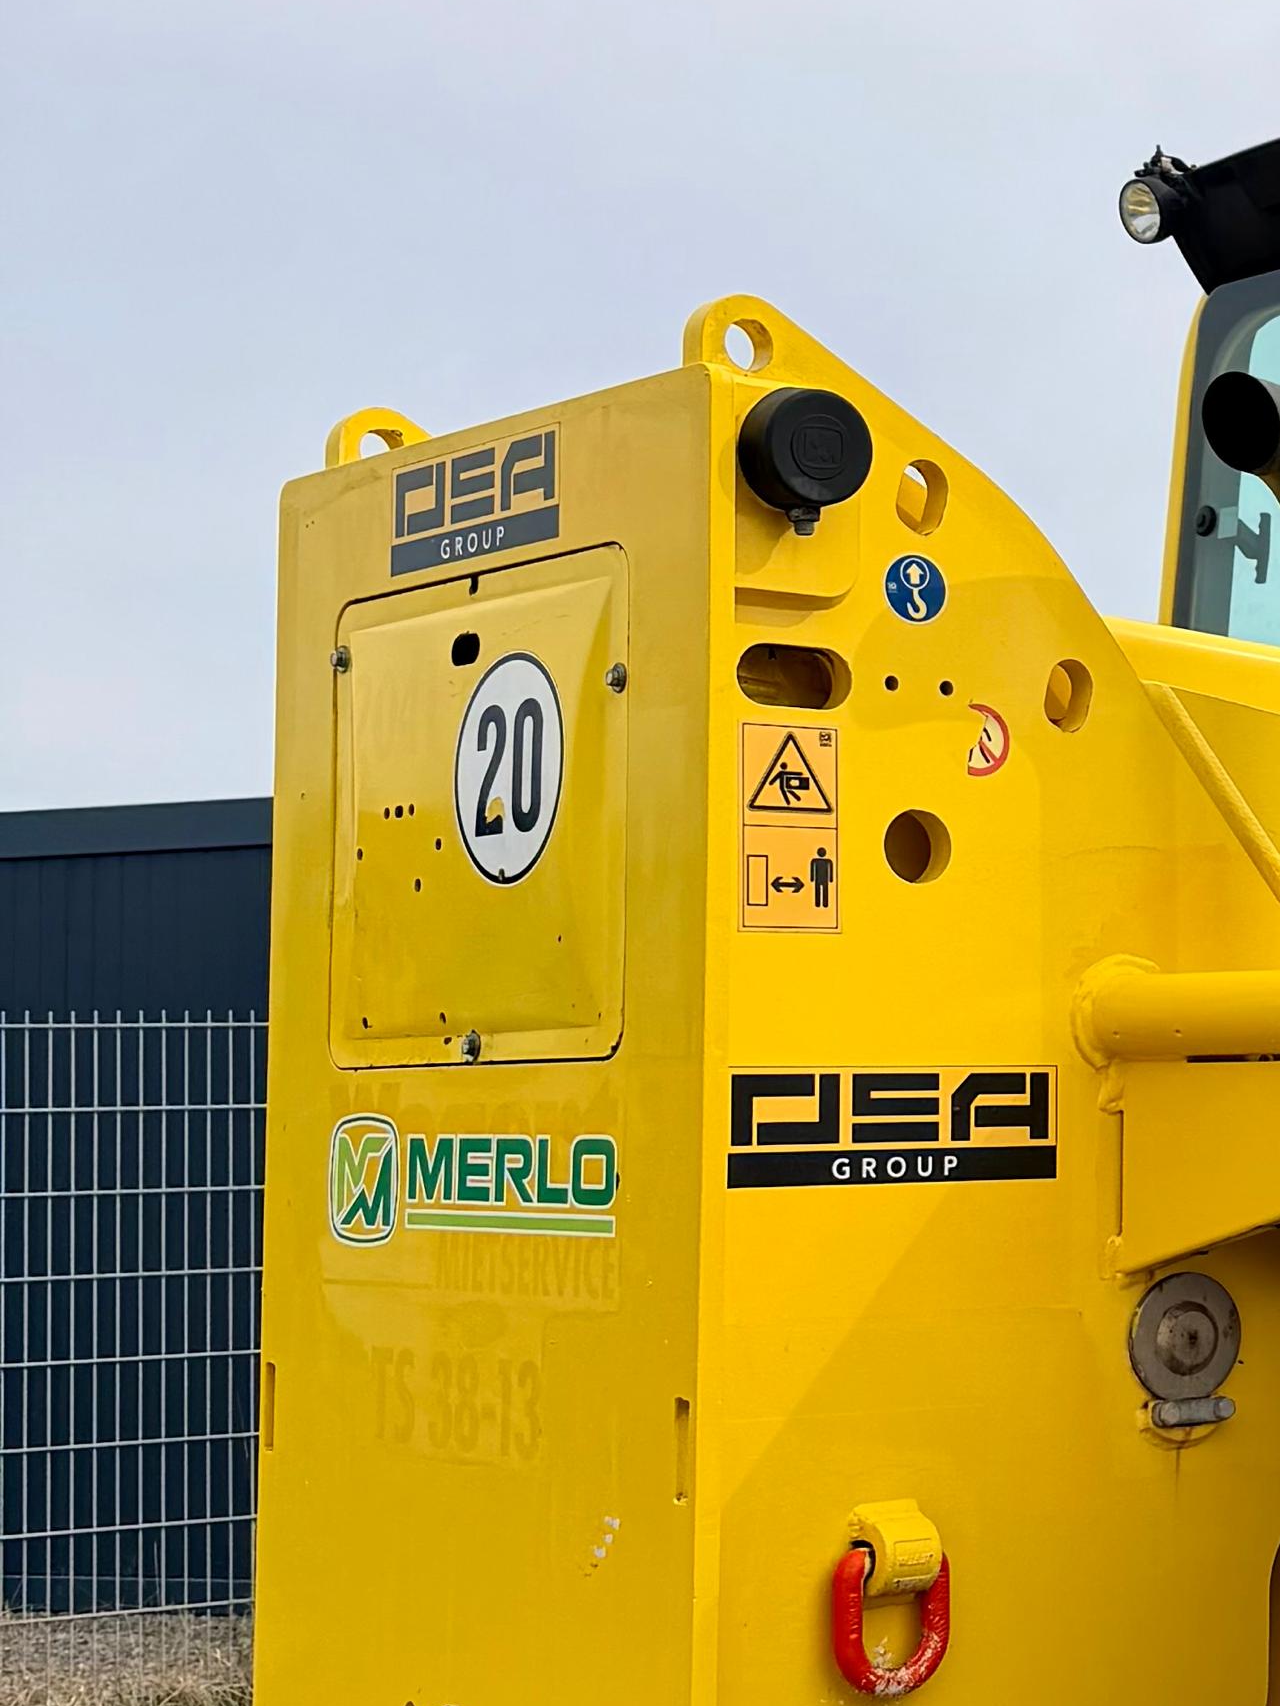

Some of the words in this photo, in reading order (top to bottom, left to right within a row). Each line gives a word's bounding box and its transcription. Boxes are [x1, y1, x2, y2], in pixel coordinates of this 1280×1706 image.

[440, 526, 505, 559] GROUP
[473, 695, 545, 839] 20
[407, 1136, 617, 1207] MERLO
[831, 1153, 960, 1180] GROUP
